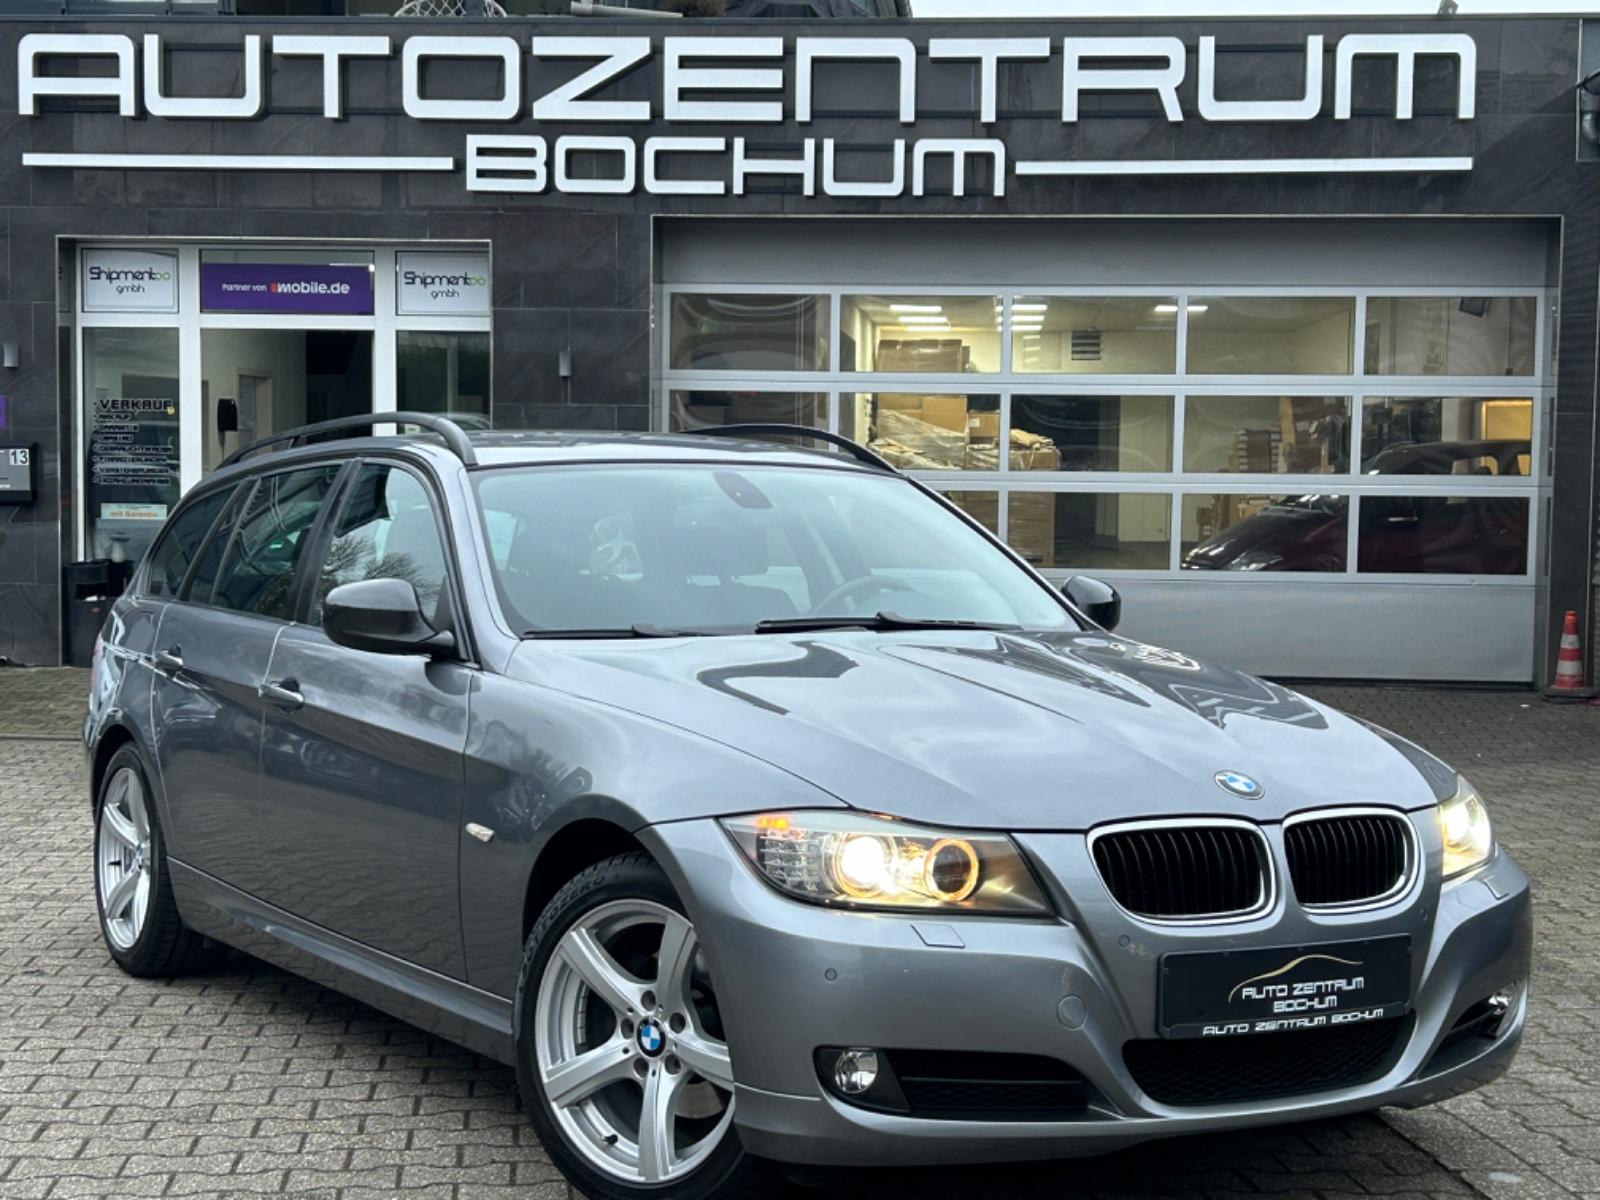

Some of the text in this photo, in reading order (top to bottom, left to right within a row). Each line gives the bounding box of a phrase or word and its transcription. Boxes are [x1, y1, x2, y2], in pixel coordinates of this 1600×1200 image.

[18, 33, 1477, 123] AUTOZENTRUM
[466, 133, 1006, 197] BOCHUM
[222, 283, 250, 291] Partner
[100, 399, 174, 411] VERKAUF
[11, 450, 28, 464] 13
[1242, 976, 1365, 1000] AUTO ZENTRUM
[1273, 995, 1338, 1013] BOCHUM
[1203, 1008, 1384, 1036] AUTO ZENTRUM BOCHUM
